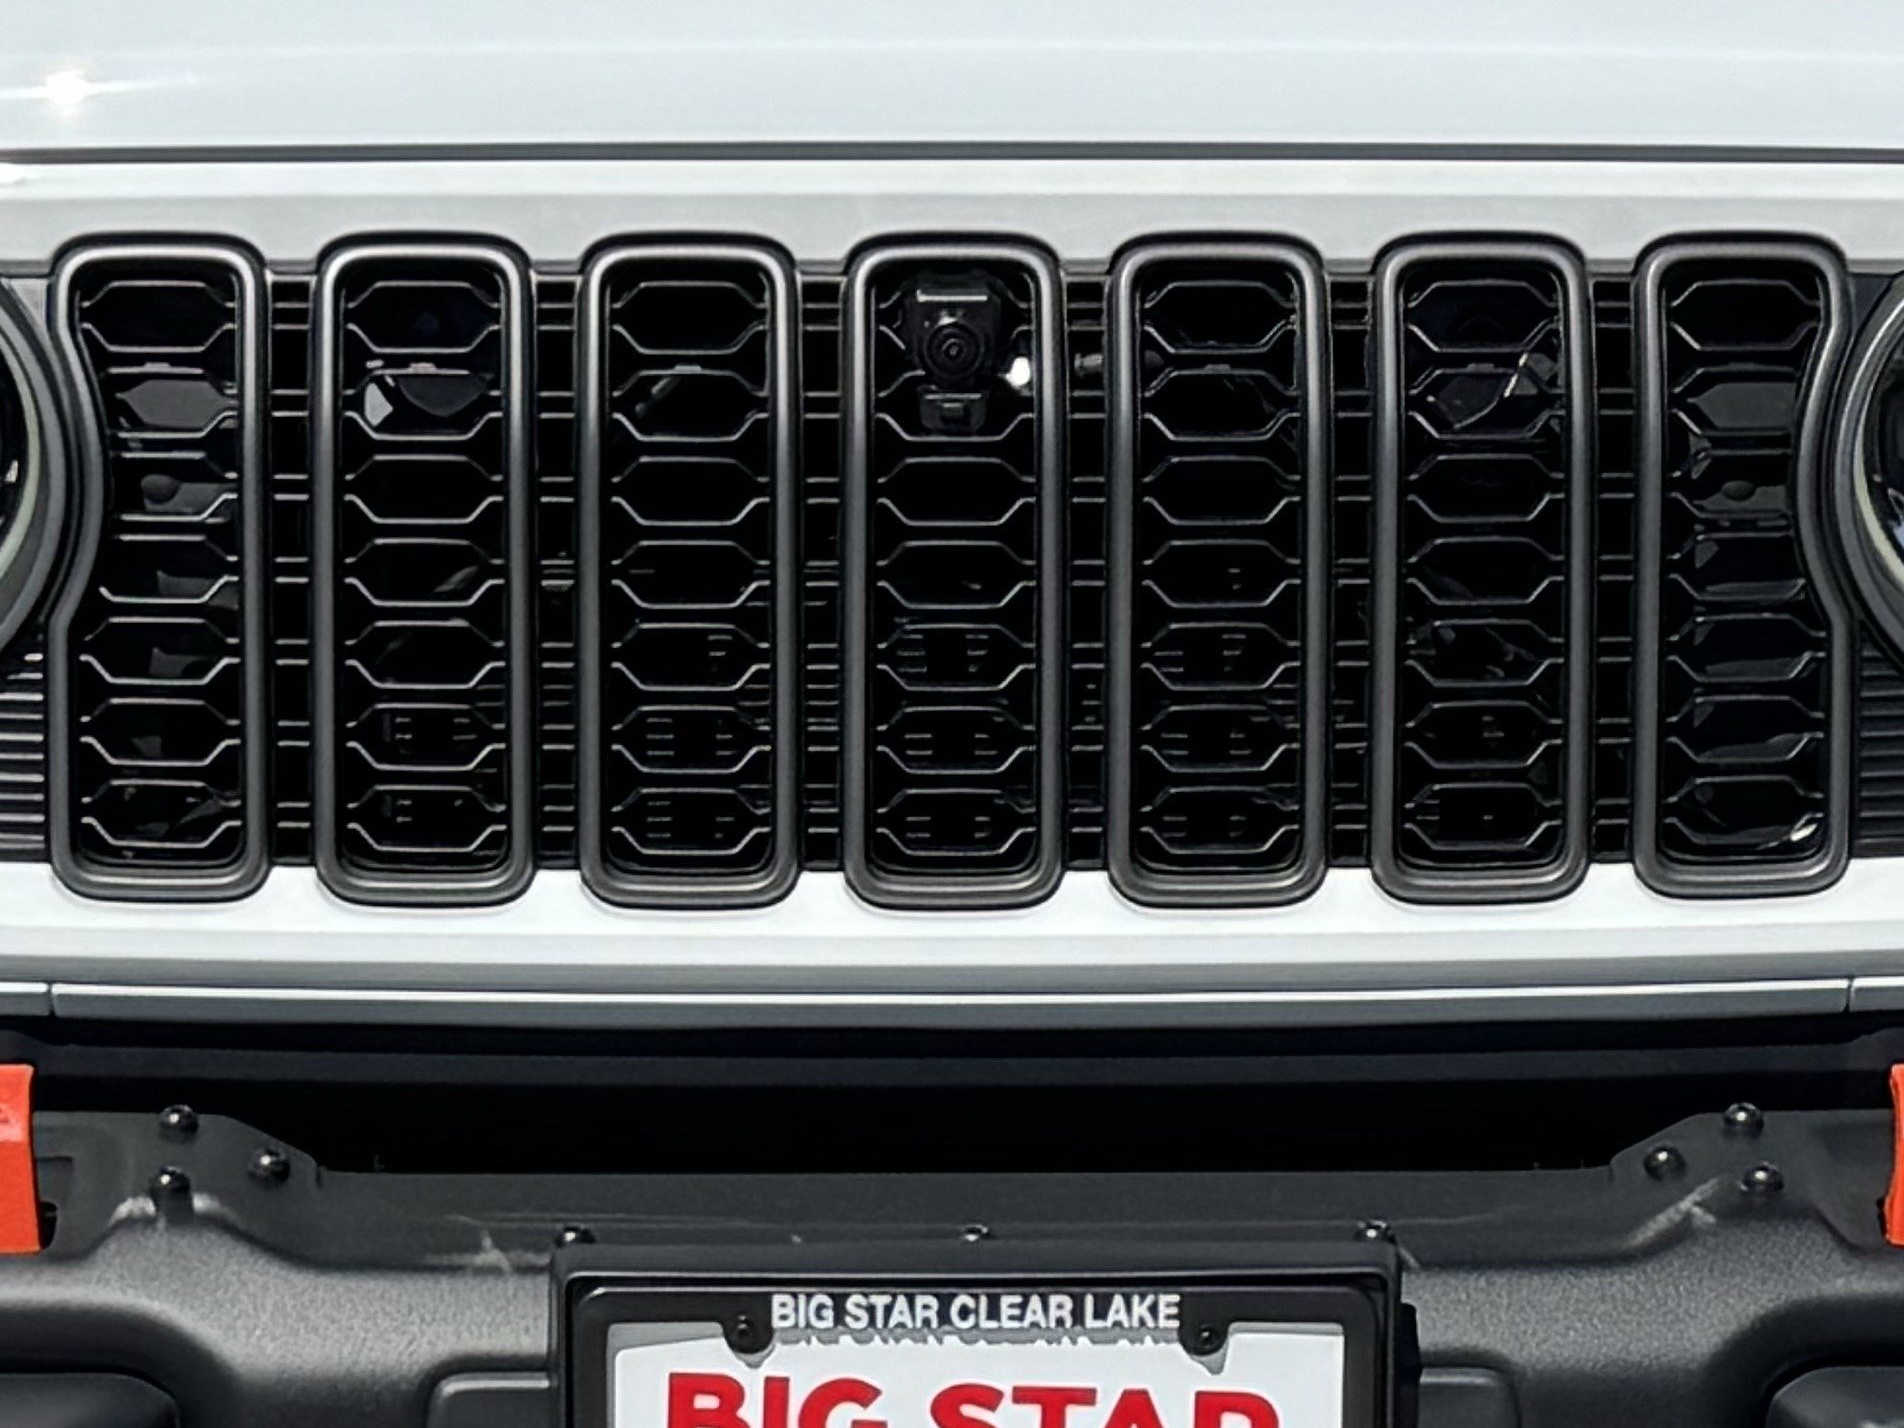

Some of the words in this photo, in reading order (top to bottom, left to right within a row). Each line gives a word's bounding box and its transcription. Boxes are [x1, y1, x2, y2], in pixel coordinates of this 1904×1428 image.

[771, 1293, 834, 1328] BIG
[844, 1293, 939, 1329] STAR
[949, 1293, 1073, 1329] CLEAR
[1084, 1293, 1181, 1329] LAKE
